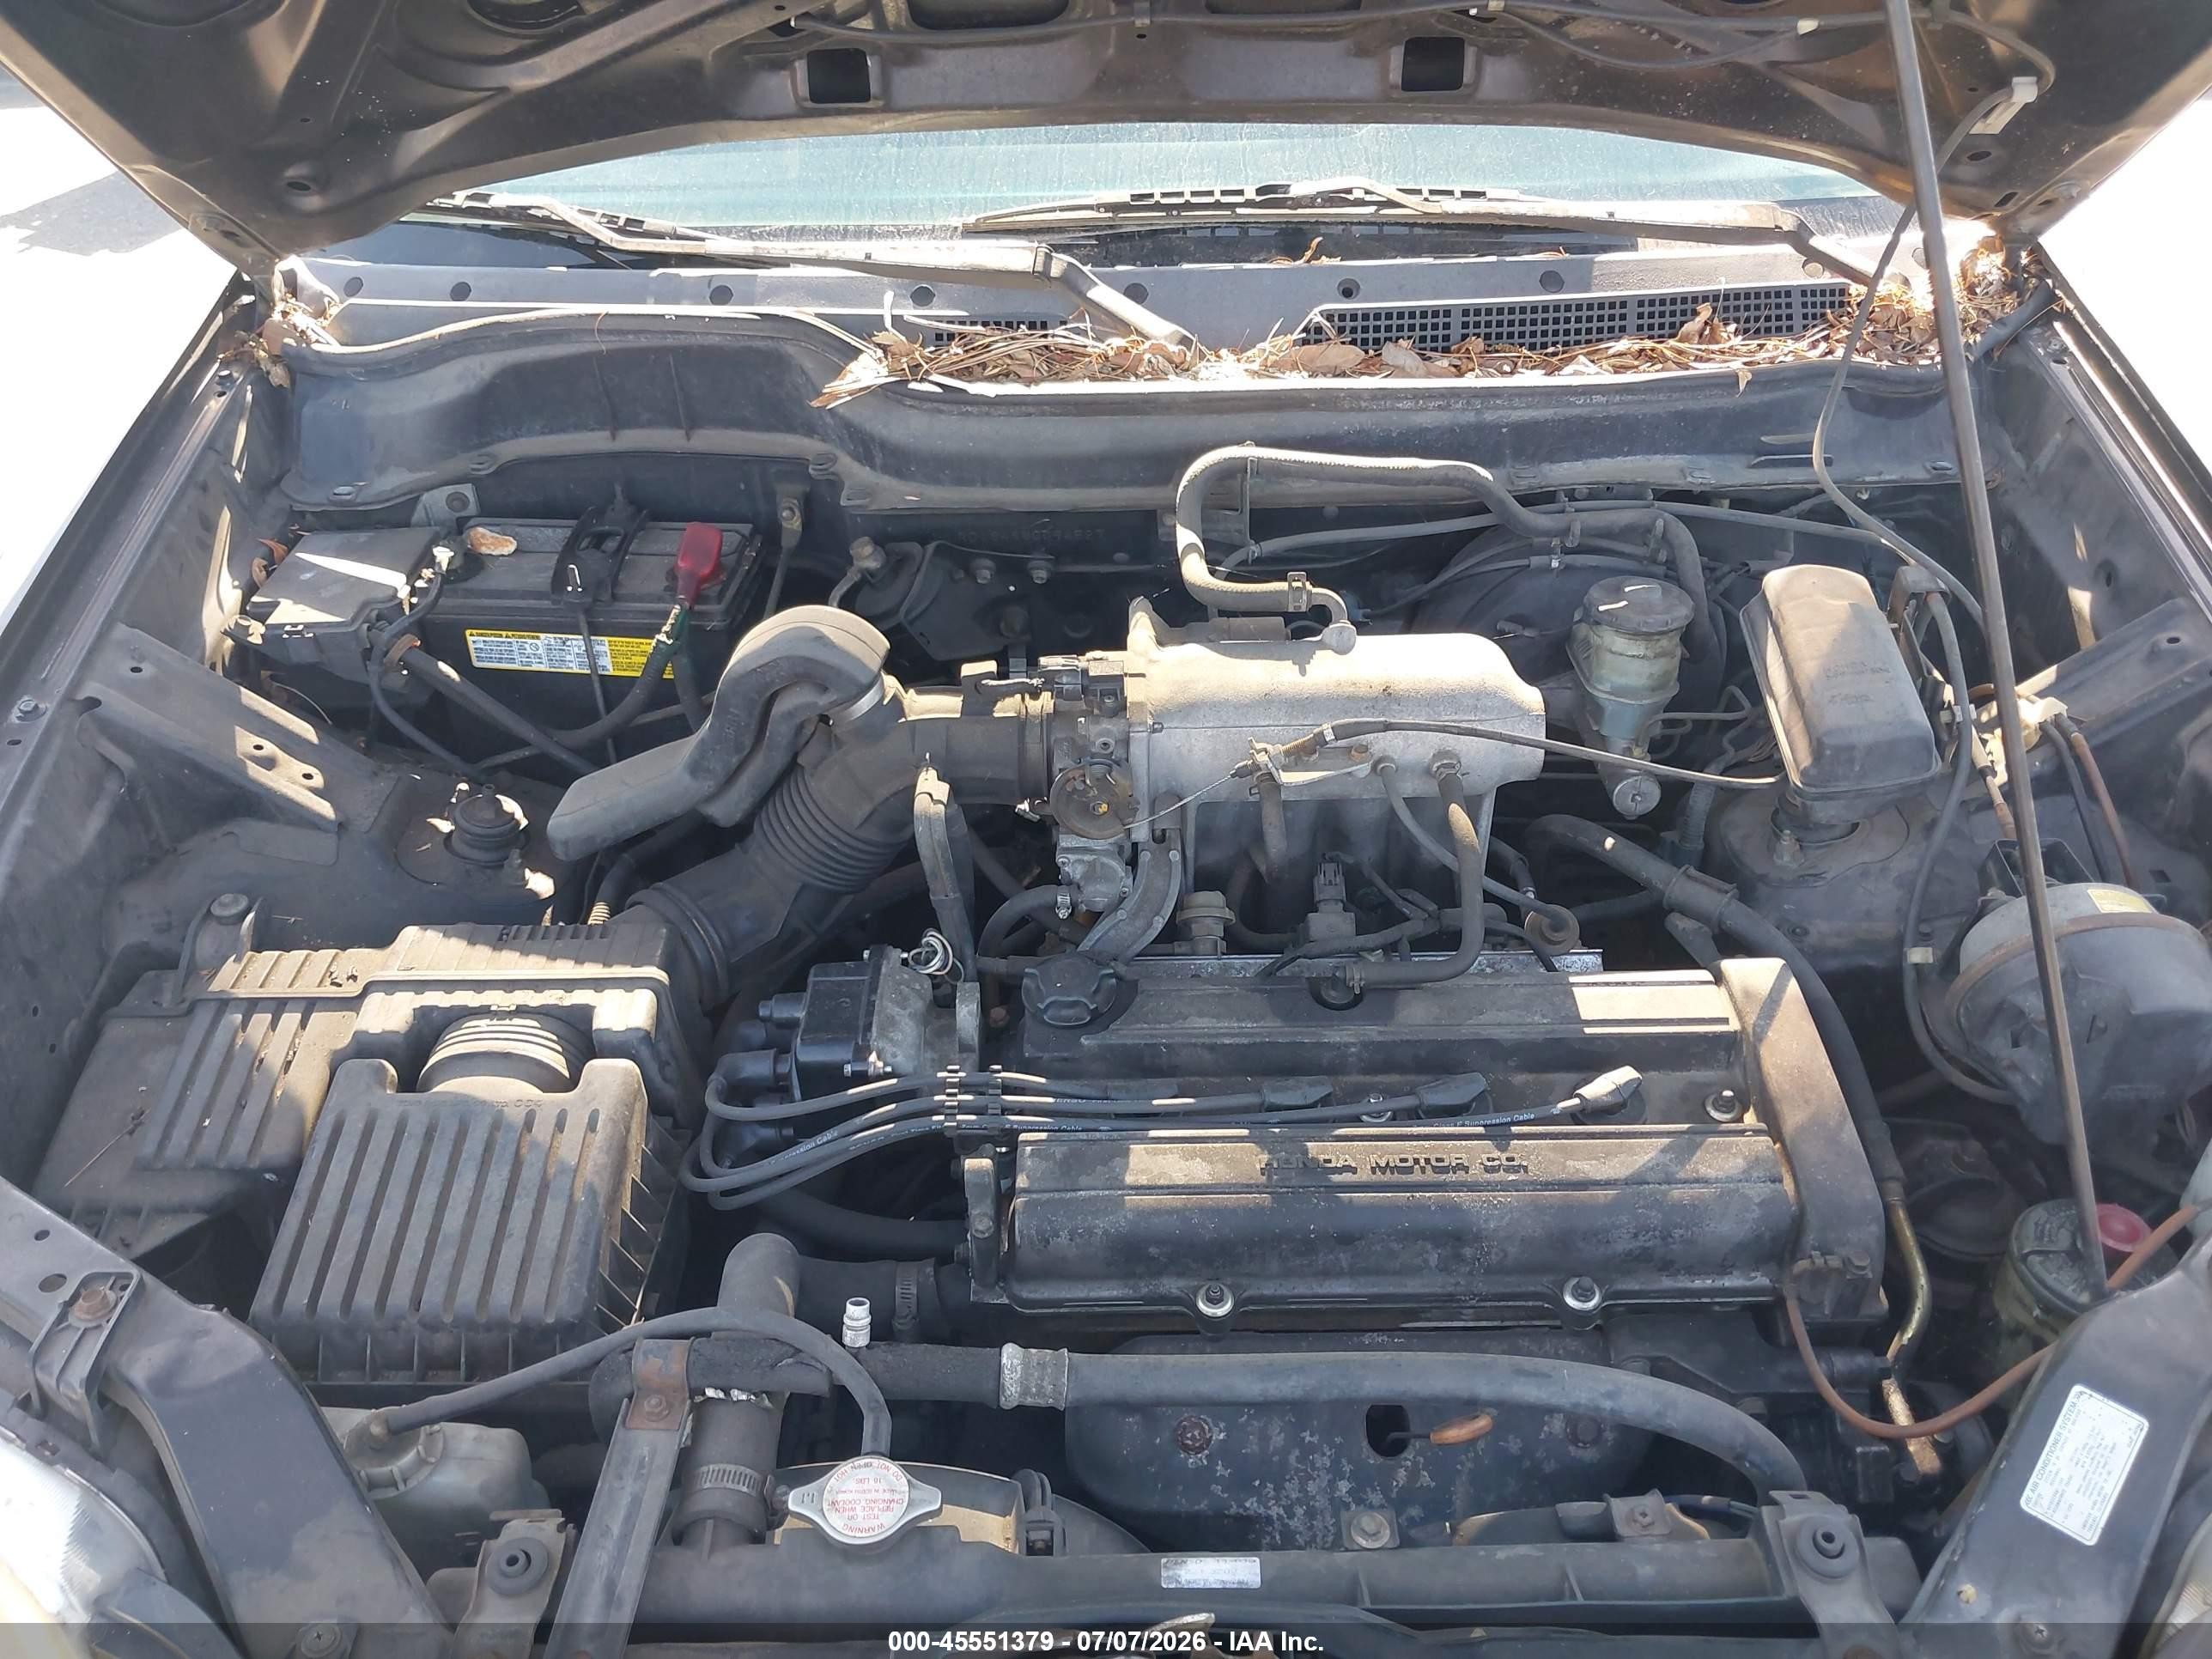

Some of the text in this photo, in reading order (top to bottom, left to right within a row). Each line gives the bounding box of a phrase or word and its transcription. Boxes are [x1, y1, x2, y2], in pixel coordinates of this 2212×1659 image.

[1513, 1112, 1535, 1121] Cable
[1258, 1153, 1528, 1171] HONDA MOTOR CO.
[2029, 1401, 2077, 1495] AIR CONDITIONER SYSTEM
[834, 1461, 902, 1481] DO NOT OPEN HOT
[827, 1498, 903, 1507] CHANGING COOLANT
[842, 1523, 885, 1534] WARNING
